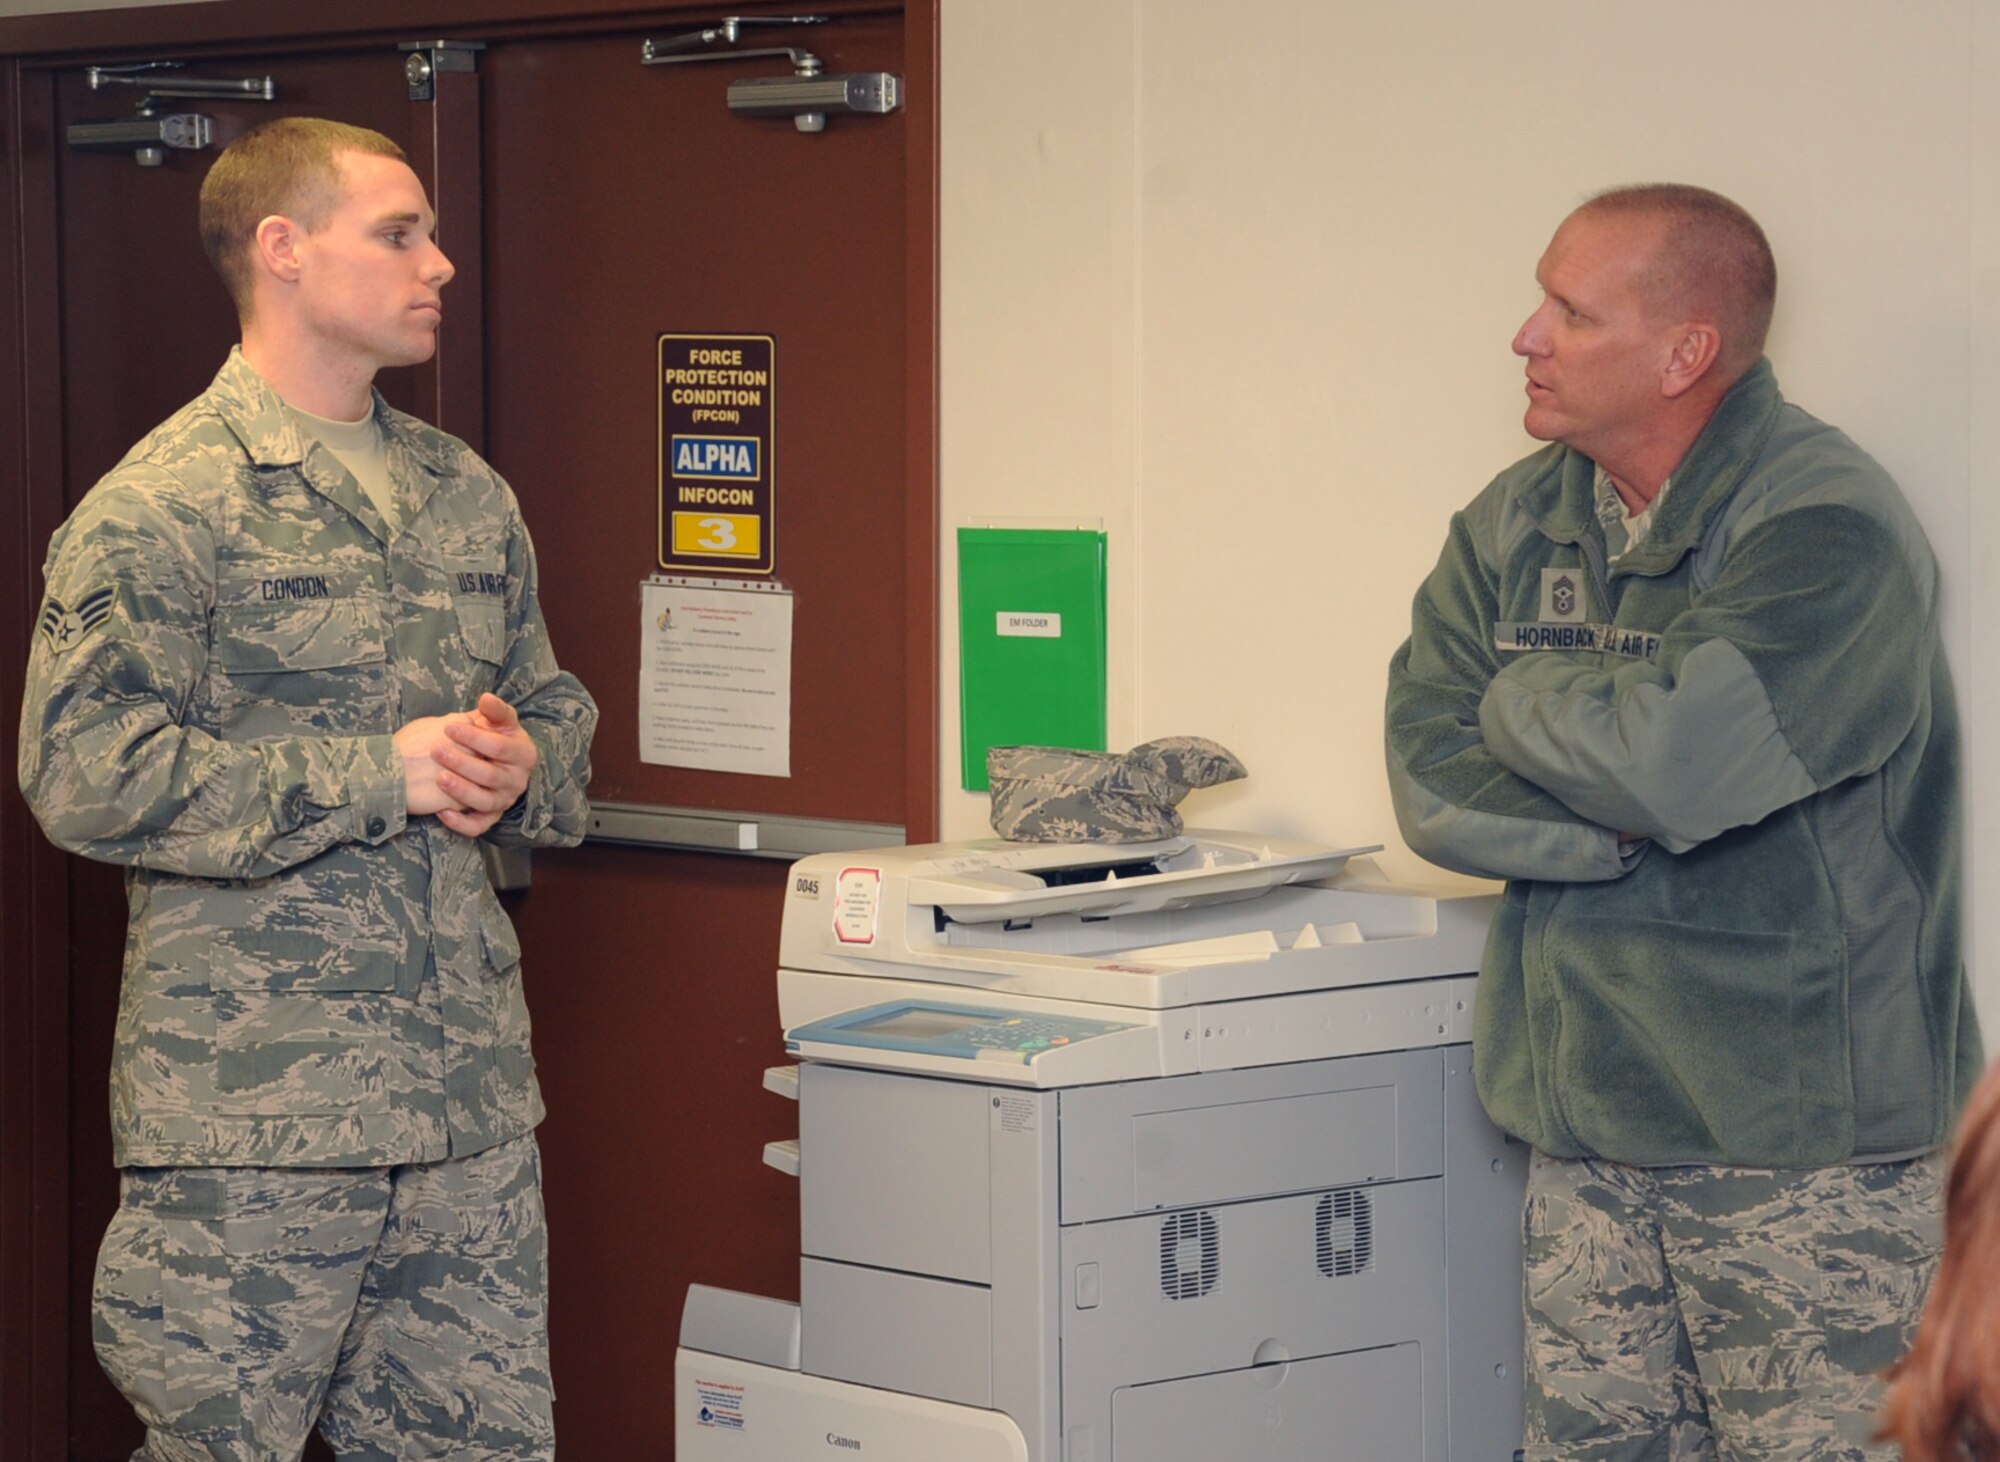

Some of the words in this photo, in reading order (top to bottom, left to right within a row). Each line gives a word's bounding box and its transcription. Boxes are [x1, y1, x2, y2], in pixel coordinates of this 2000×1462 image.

[689, 349, 742, 366] FORCE
[665, 368, 767, 386] PROTECTION
[671, 388, 761, 406] CONDITION
[692, 409, 740, 424] (FPCON)
[676, 443, 752, 473] ALPHA
[678, 487, 754, 506] INFOCON
[697, 518, 737, 550] 3
[262, 576, 329, 600] CONDON
[1022, 618, 1048, 628] FOLDER
[1515, 626, 1596, 649] HORNBACK
[1621, 632, 1643, 657] AIR
[796, 878, 819, 894] 0045
[826, 1432, 861, 1450] Canon
